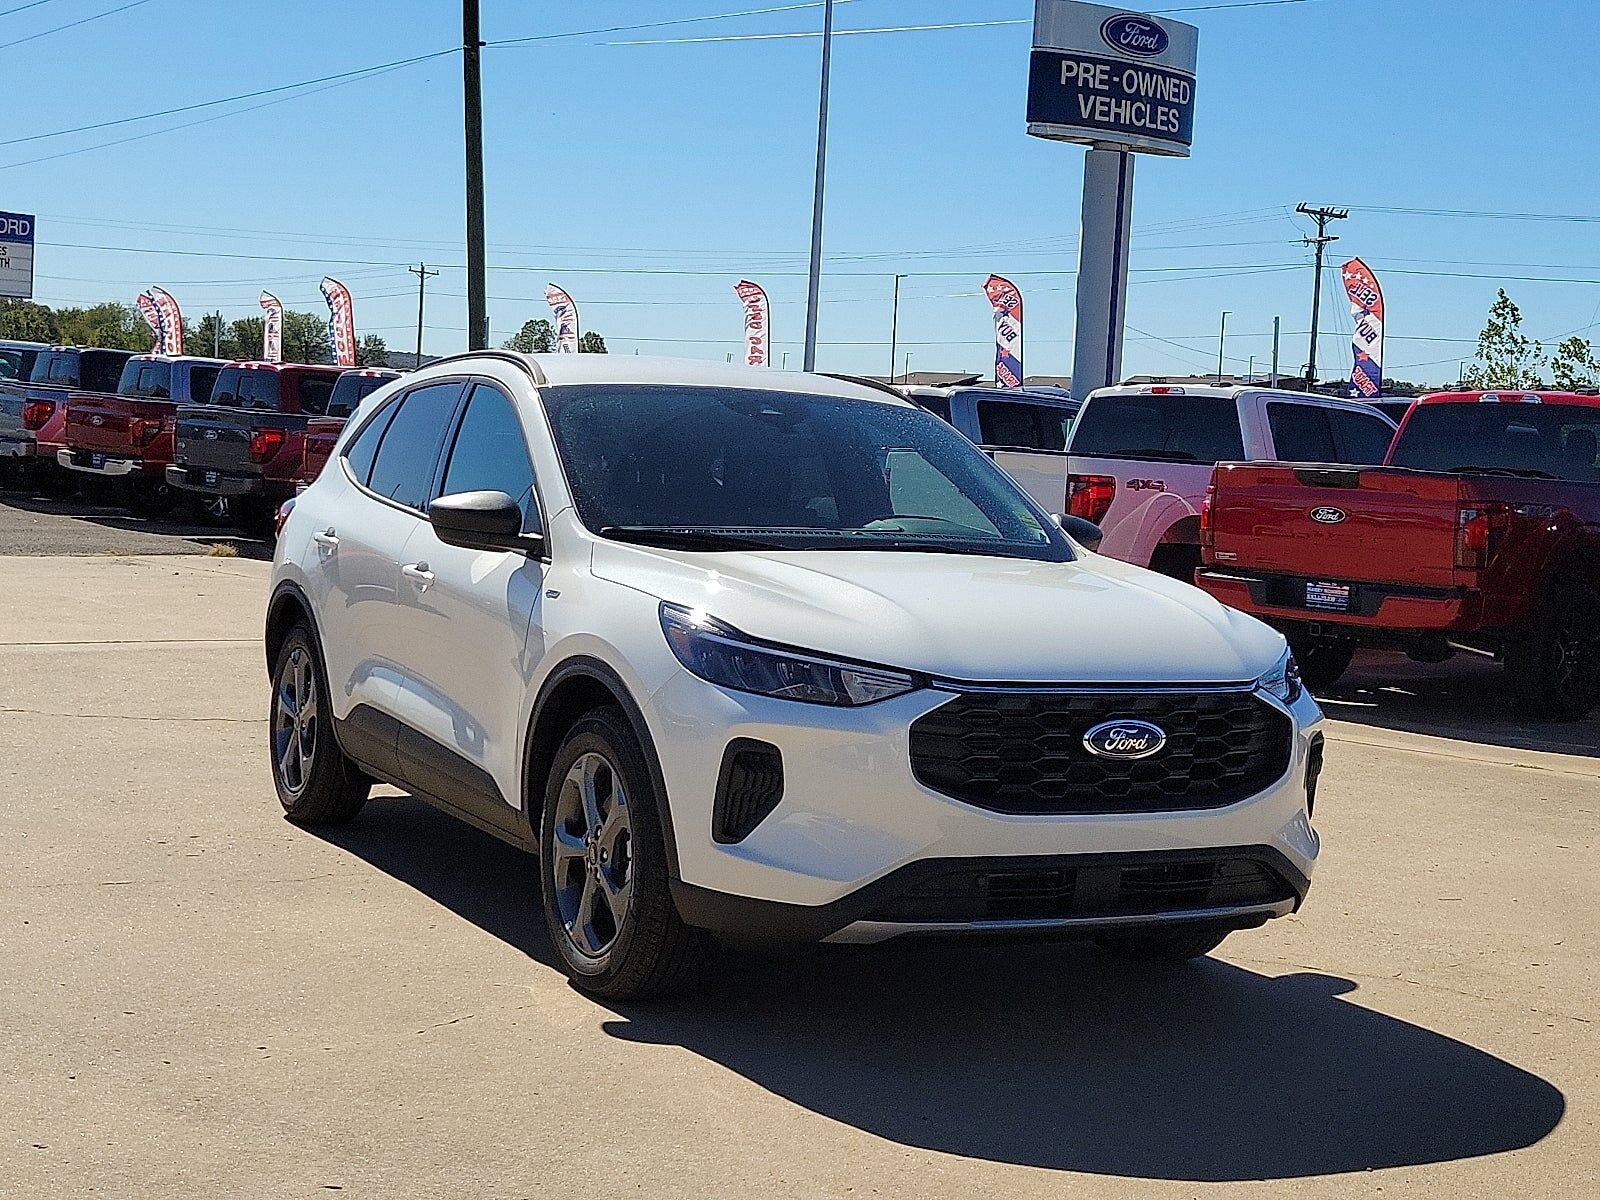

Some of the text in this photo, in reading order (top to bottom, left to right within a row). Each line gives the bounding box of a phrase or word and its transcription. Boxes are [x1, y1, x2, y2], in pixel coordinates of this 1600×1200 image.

[1120, 22, 1158, 50] Ford
[1078, 94, 1179, 133] VEHICLES
[1315, 508, 1340, 521] Ford
[1104, 727, 1149, 751] Ford
